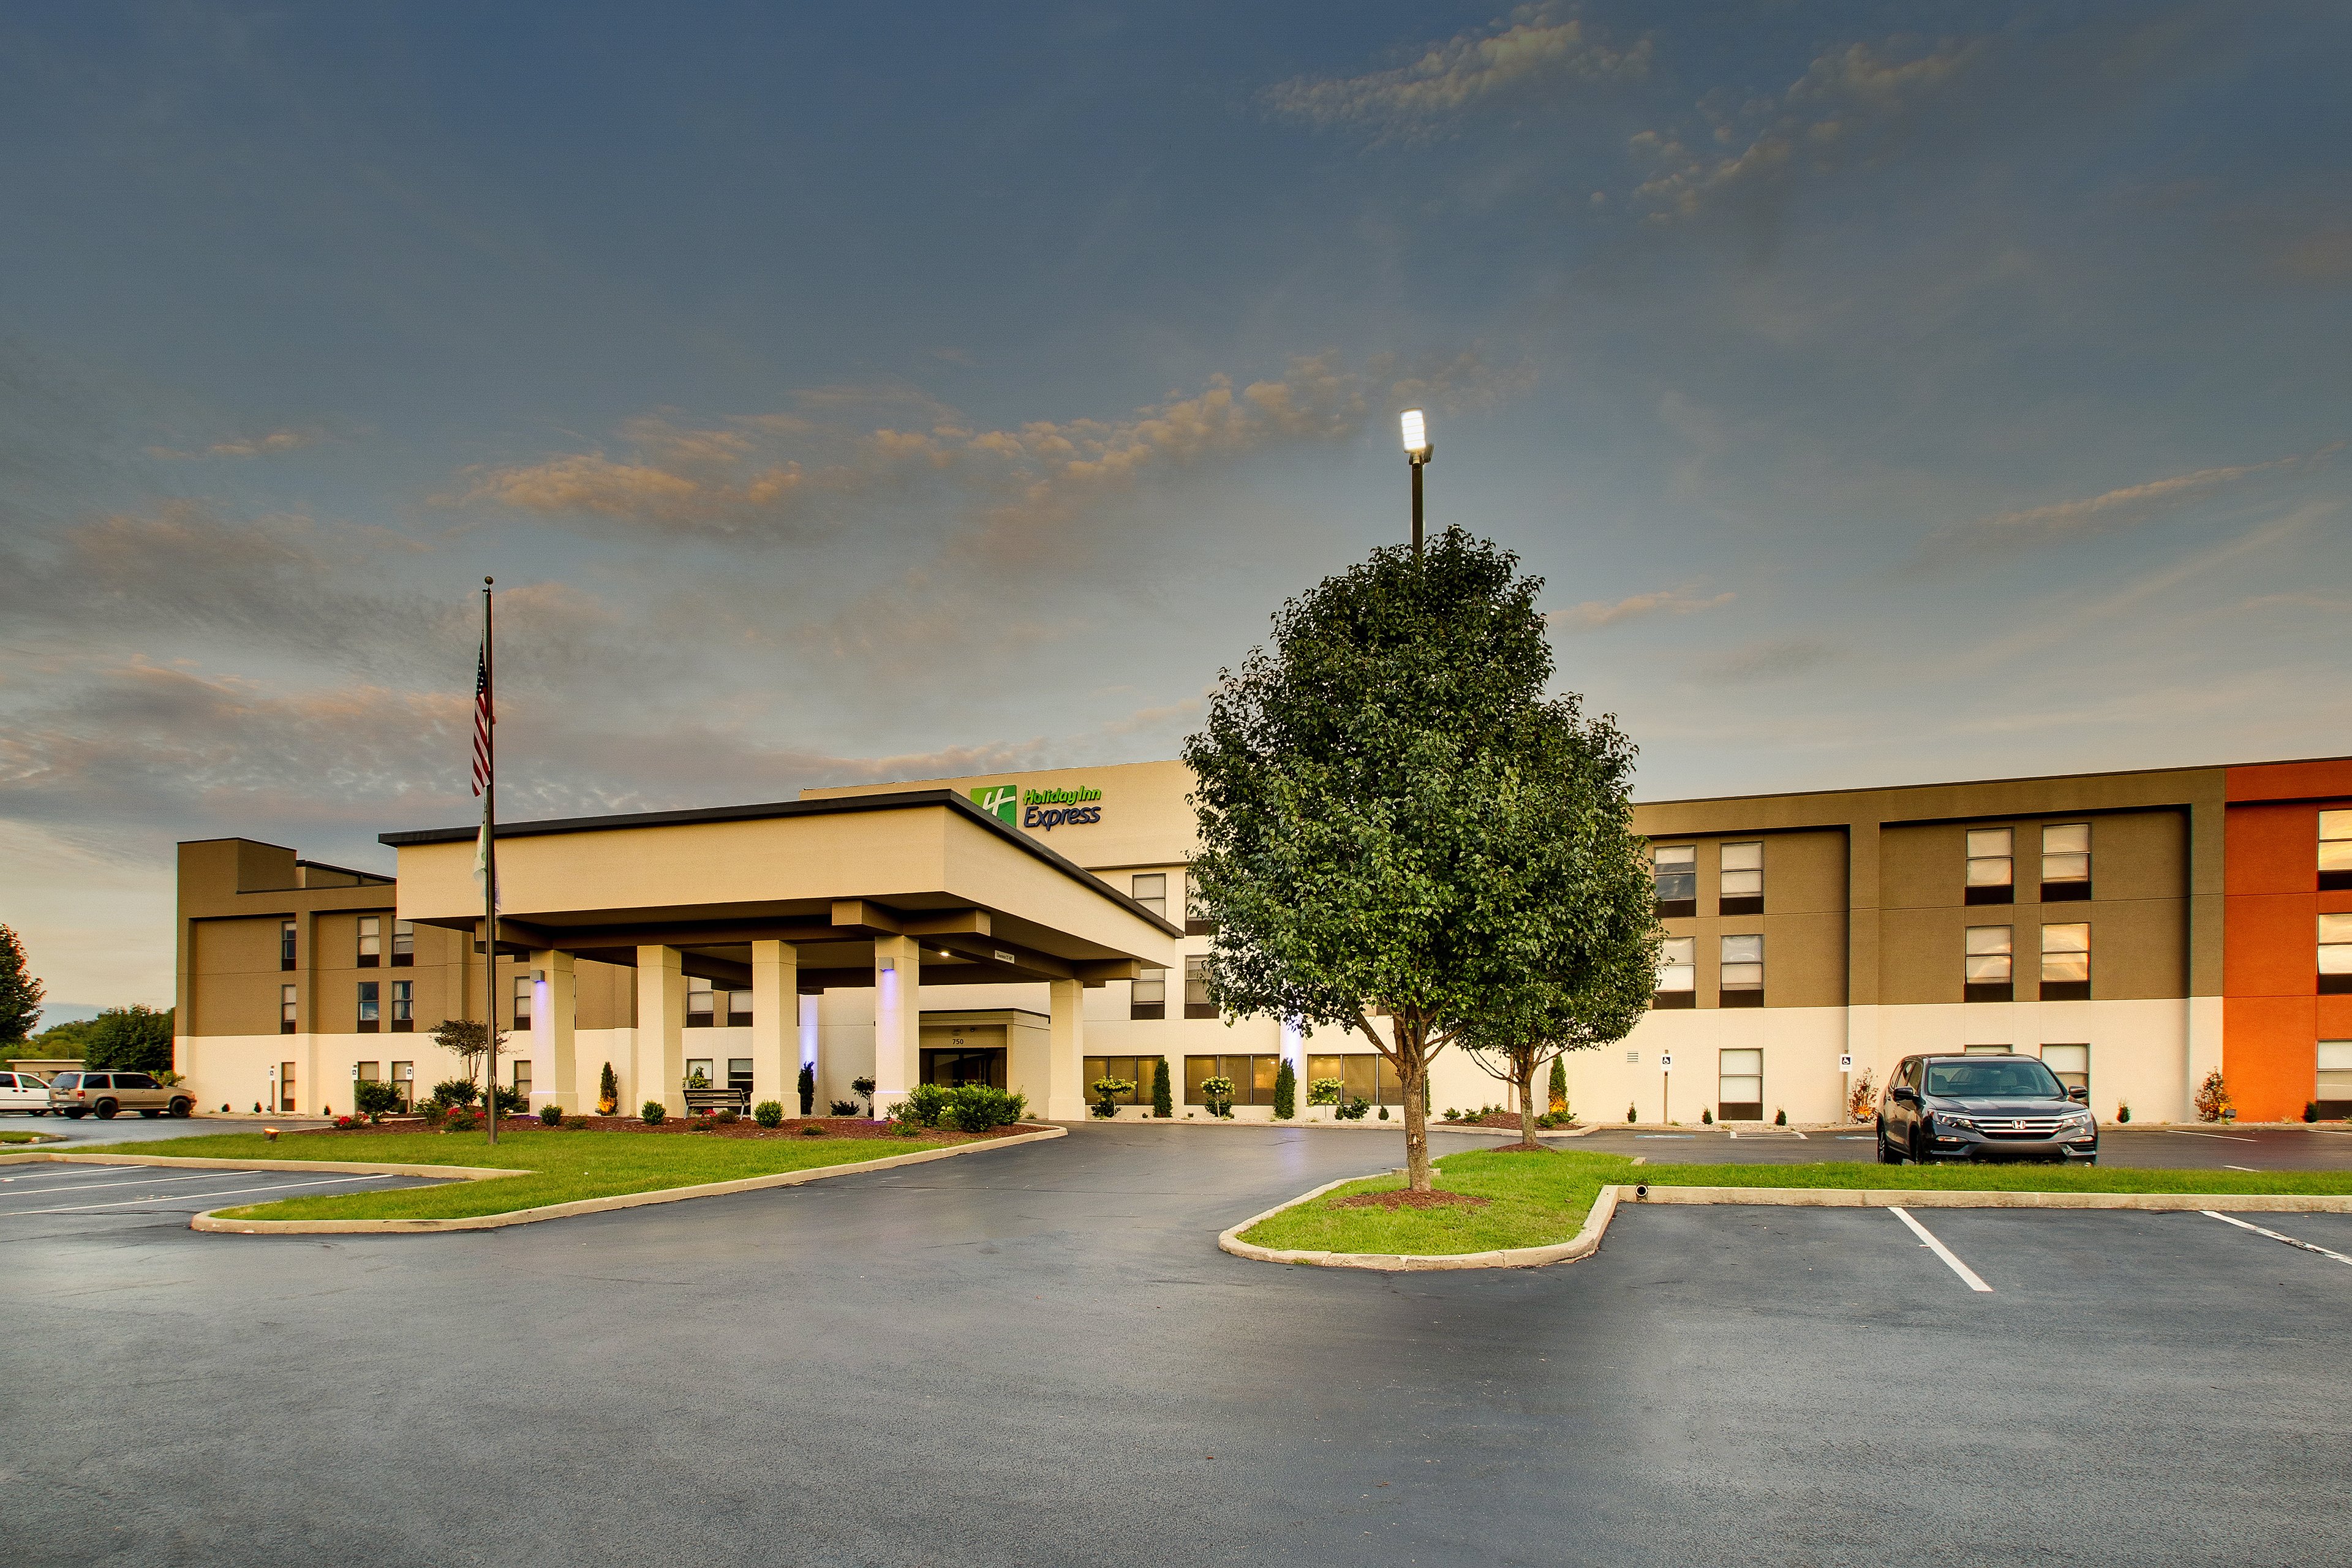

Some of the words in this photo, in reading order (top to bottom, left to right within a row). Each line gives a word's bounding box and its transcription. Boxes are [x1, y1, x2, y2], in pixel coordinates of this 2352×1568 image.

[1023, 788, 1078, 805] Holiday
[1079, 785, 1101, 801] Inn
[1023, 806, 1101, 831] Express
